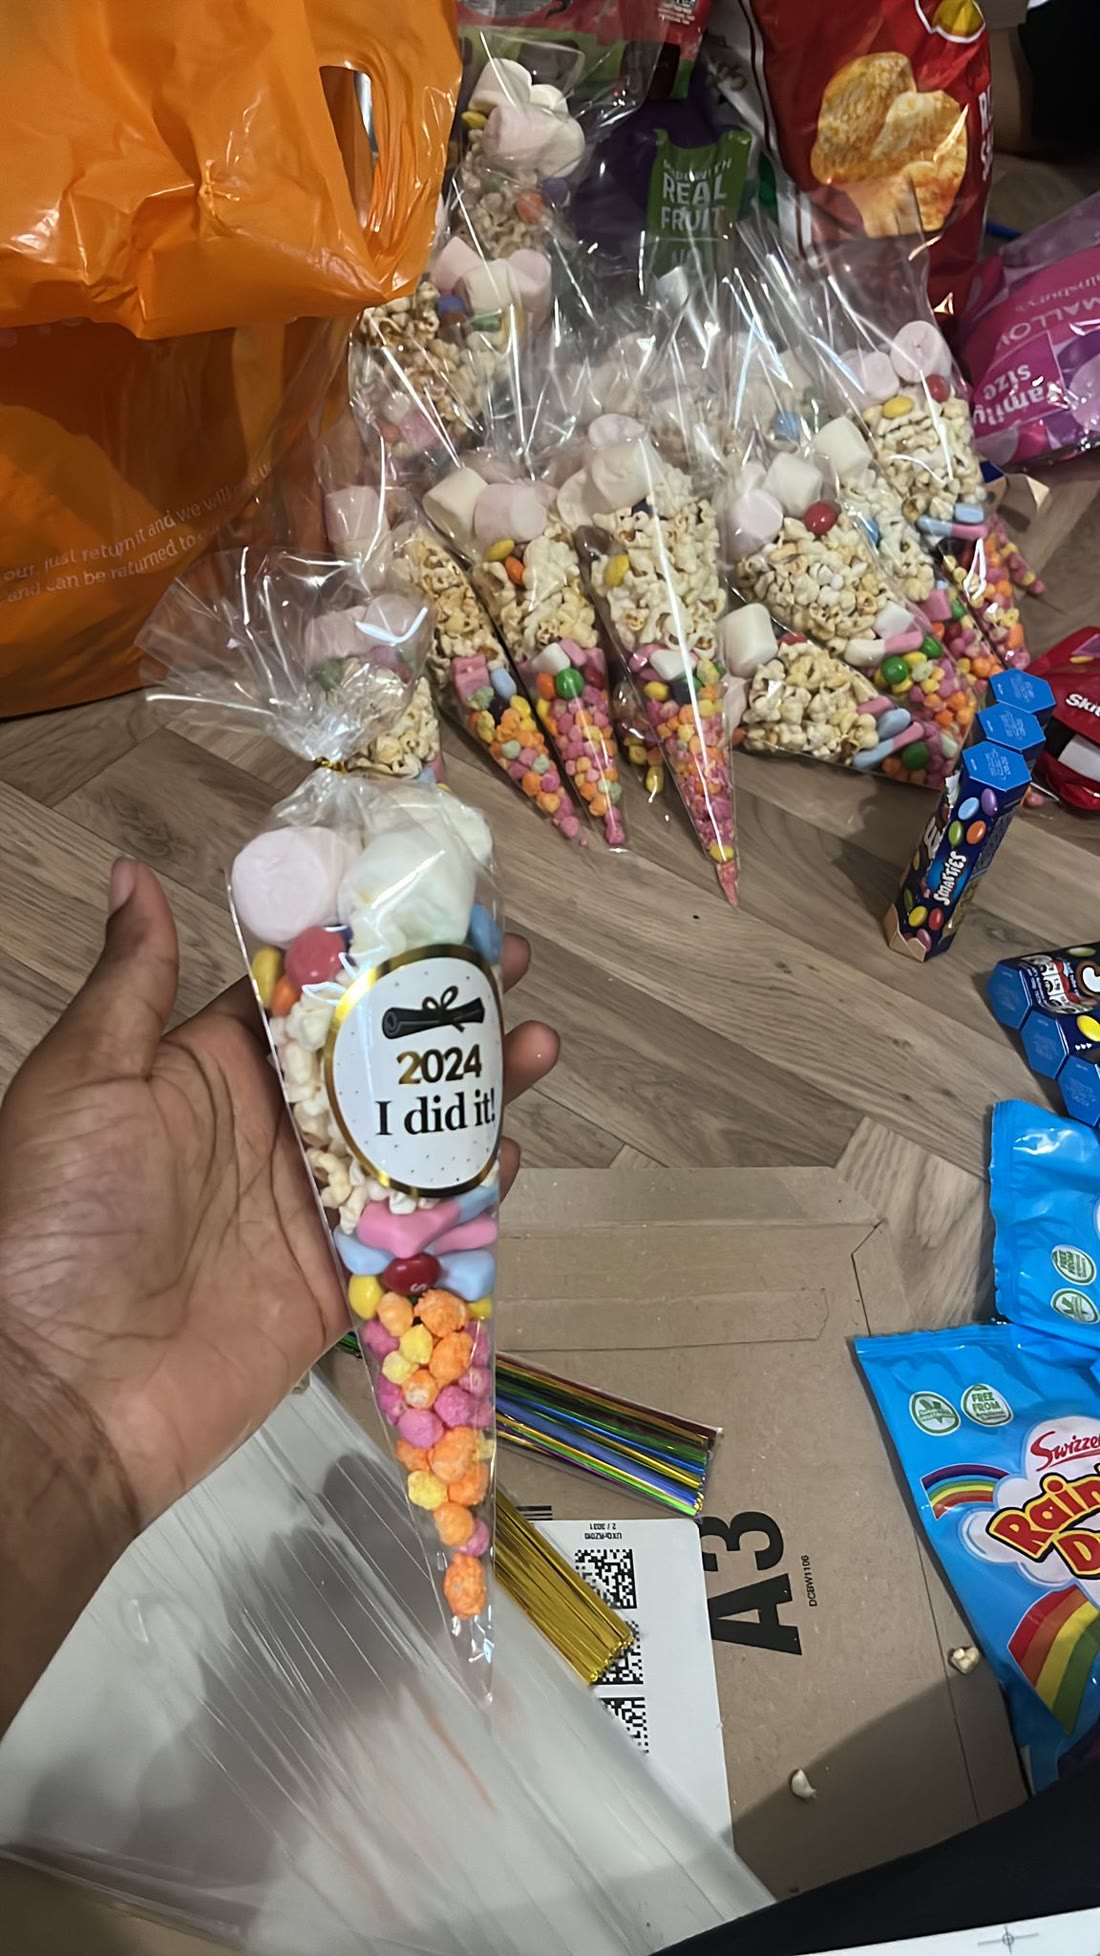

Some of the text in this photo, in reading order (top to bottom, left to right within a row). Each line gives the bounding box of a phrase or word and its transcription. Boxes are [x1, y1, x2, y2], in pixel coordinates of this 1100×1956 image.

[663, 172, 727, 206] REAL
[661, 206, 726, 231] FRUIT
[983, 364, 1032, 400] size
[81, 536, 136, 562] return
[148, 509, 177, 537] and
[175, 503, 201, 521] we
[8, 581, 41, 602] and
[83, 570, 106, 585] be
[111, 538, 178, 579] returned
[179, 535, 196, 551] to
[396, 1044, 483, 1085] 2024
[375, 1086, 496, 1135] I did it!
[971, 1391, 994, 1402] FREE
[972, 1401, 1001, 1412] FROM
[700, 1511, 803, 1656] A3
